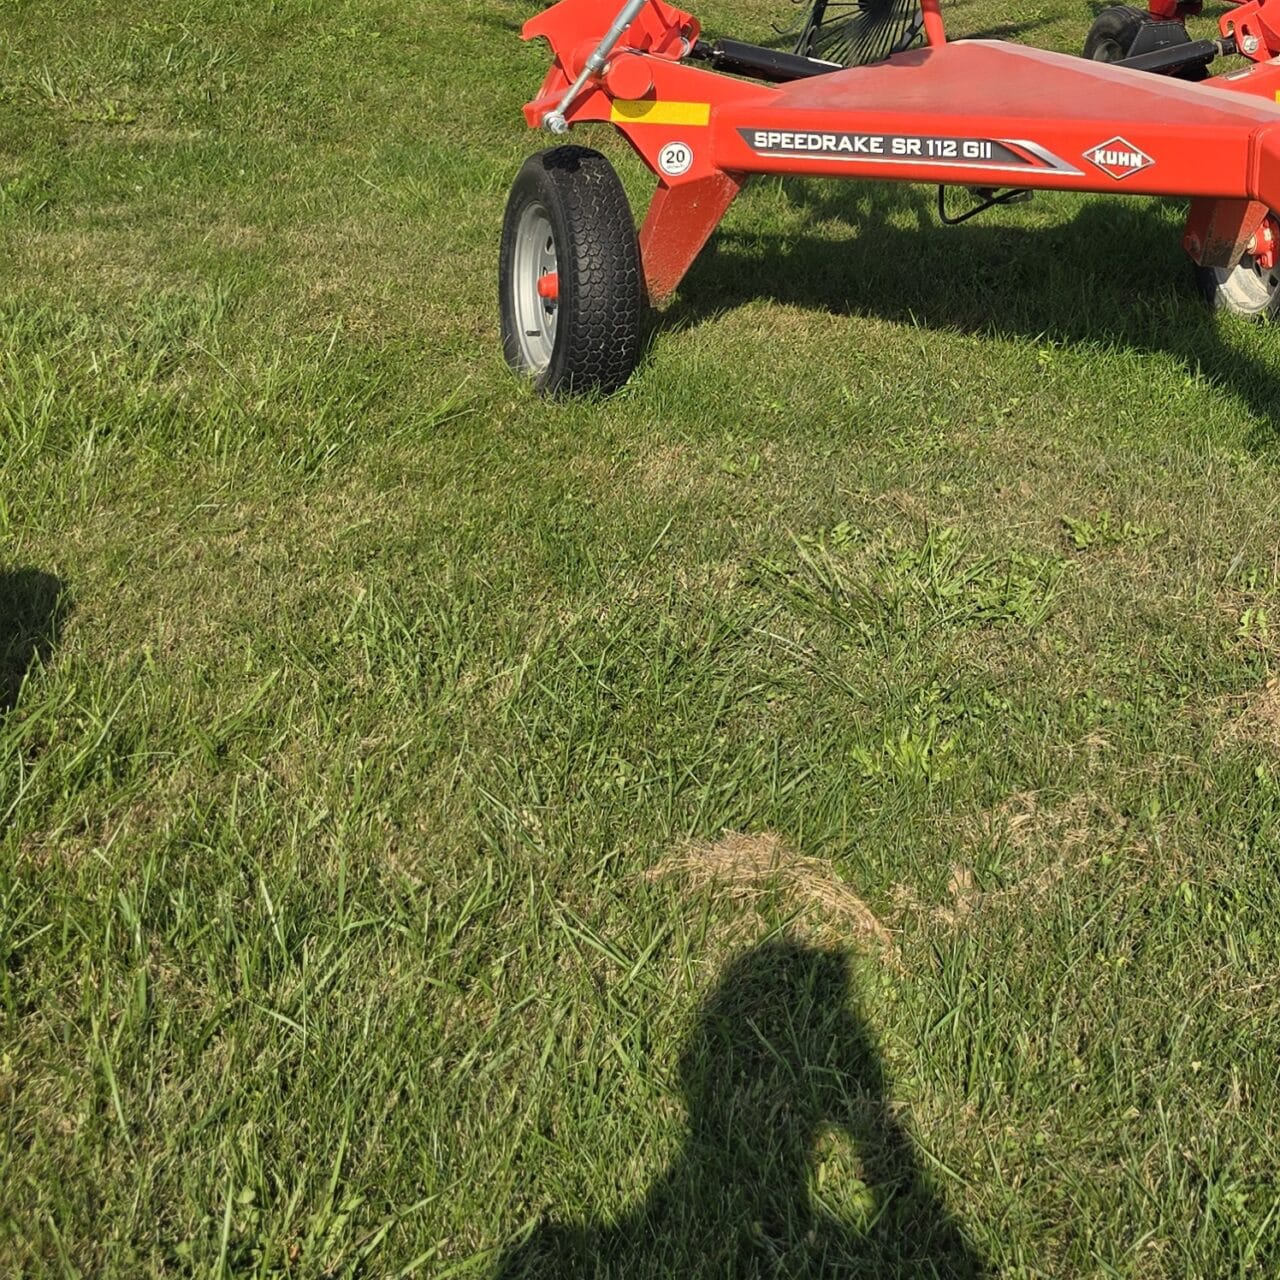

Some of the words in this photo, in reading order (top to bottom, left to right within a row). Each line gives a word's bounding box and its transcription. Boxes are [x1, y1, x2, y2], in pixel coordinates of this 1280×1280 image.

[754, 132, 884, 154] SPEEDRAKE
[891, 138, 922, 156] SR
[927, 140, 957, 157] 112
[963, 141, 992, 158] GII
[666, 150, 685, 164] 20
[1095, 149, 1142, 168] KUHN
